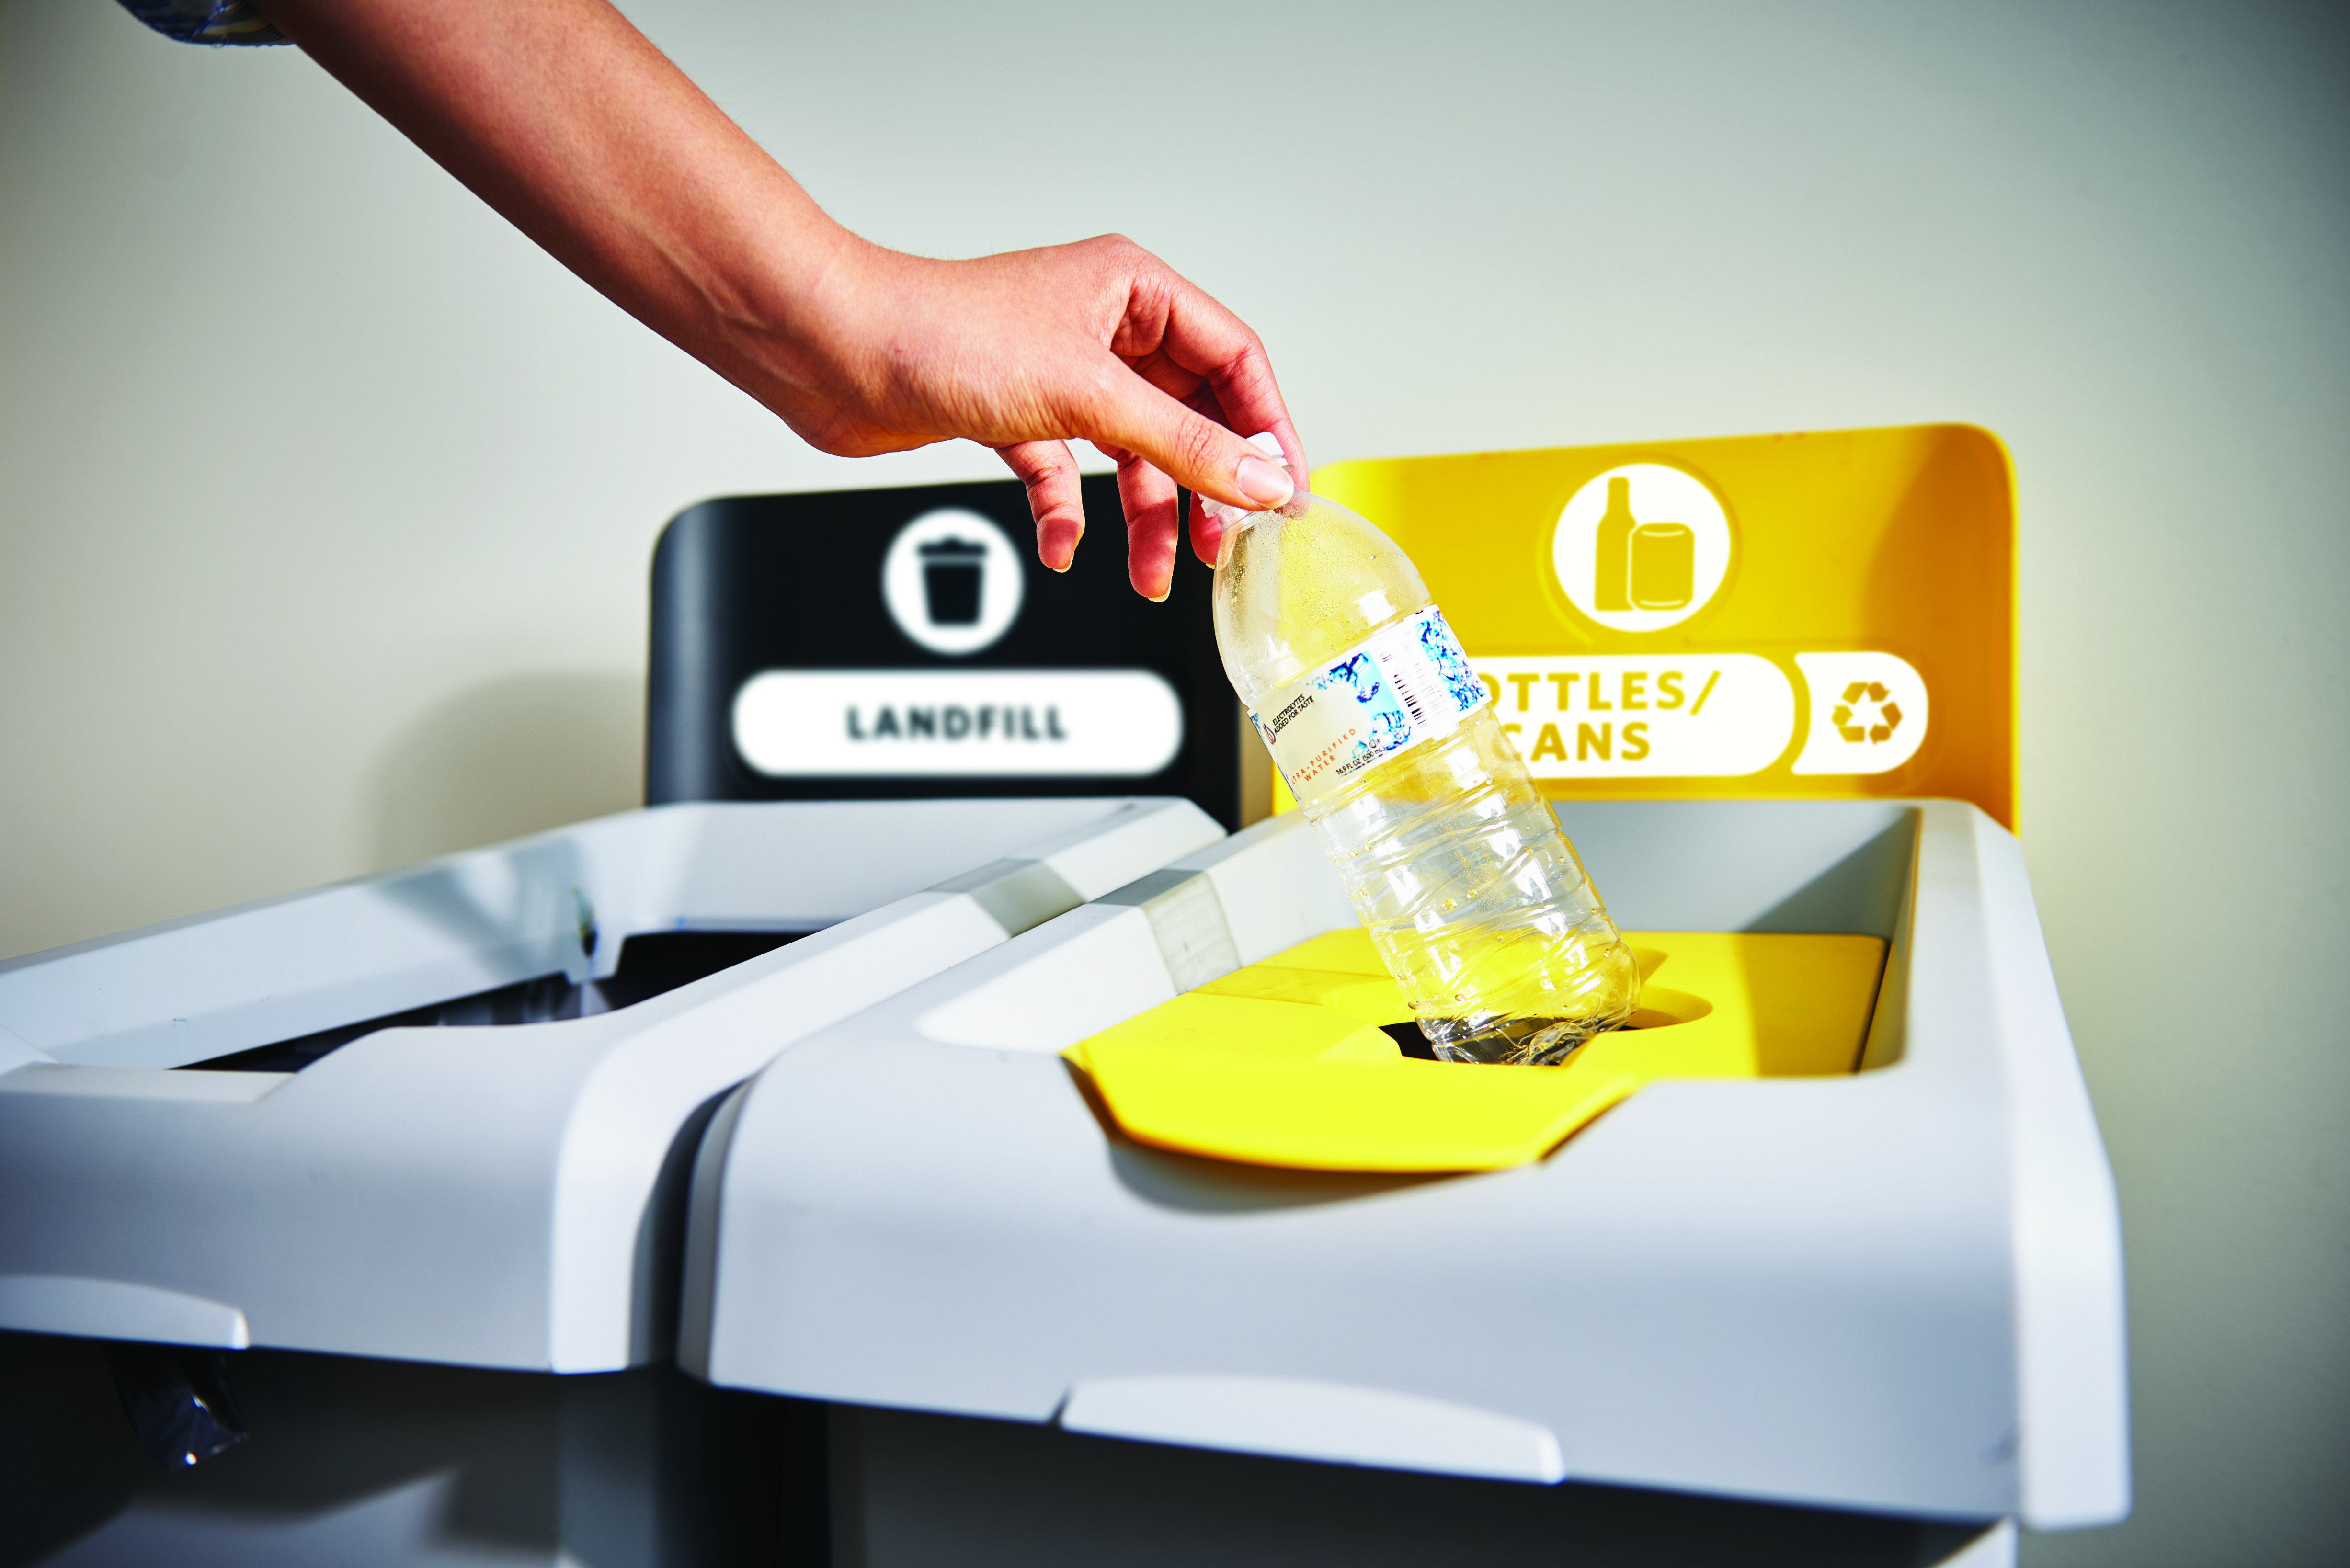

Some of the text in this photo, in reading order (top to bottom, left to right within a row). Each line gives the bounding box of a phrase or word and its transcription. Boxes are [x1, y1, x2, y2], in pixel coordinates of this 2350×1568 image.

[1272, 694, 1305, 726] ELECTROLYTES
[1477, 671, 1721, 716] TTLES/
[846, 706, 1067, 740] LANDFILL
[1274, 695, 1314, 735] ADDED FOR TASTE
[1291, 728, 1356, 786] LTRA-PURIFIED
[1304, 755, 1335, 781] WATER
[1336, 766, 1346, 774] 16.9
